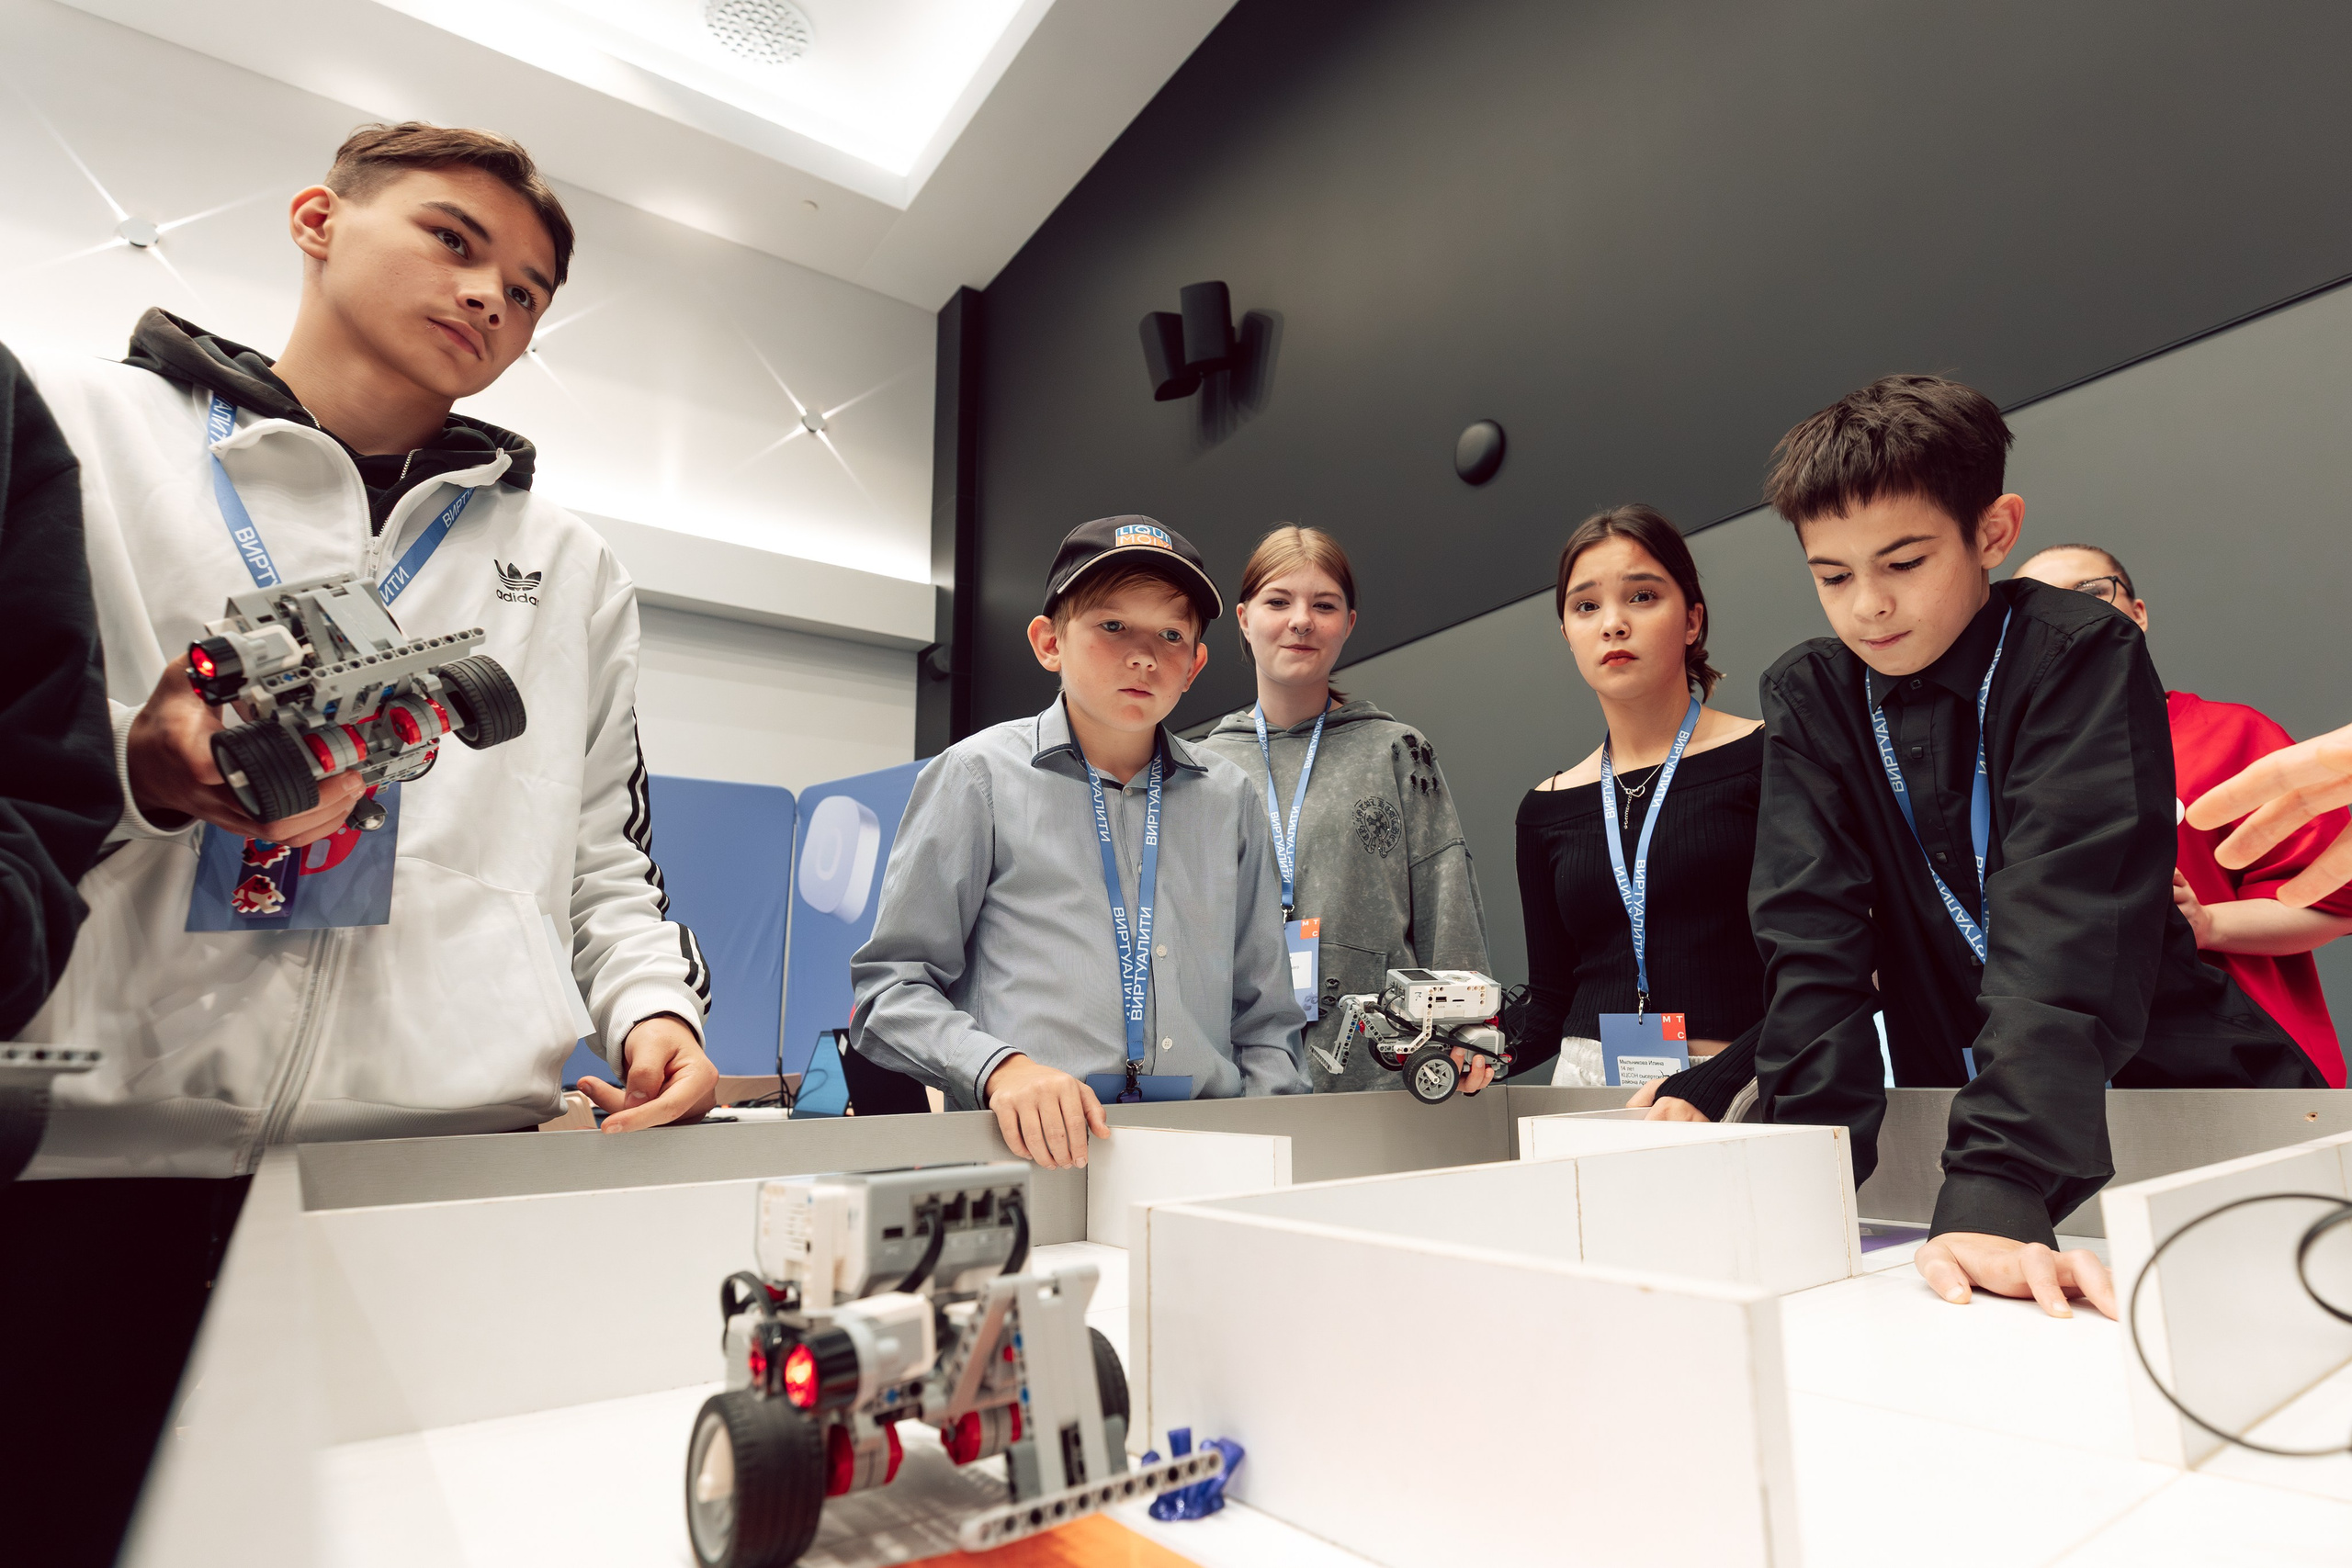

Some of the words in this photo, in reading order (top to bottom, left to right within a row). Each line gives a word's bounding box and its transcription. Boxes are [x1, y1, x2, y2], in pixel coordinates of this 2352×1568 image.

[1652, 730, 1690, 807] ВИРТУАЛИТИ
[1271, 811, 1291, 883] ВИРТУАЛИТИ
[1634, 860, 1645, 959] ВИРТУАЛИТИ
[1131, 907, 1152, 1021] ВИРТУАЛИТИ
